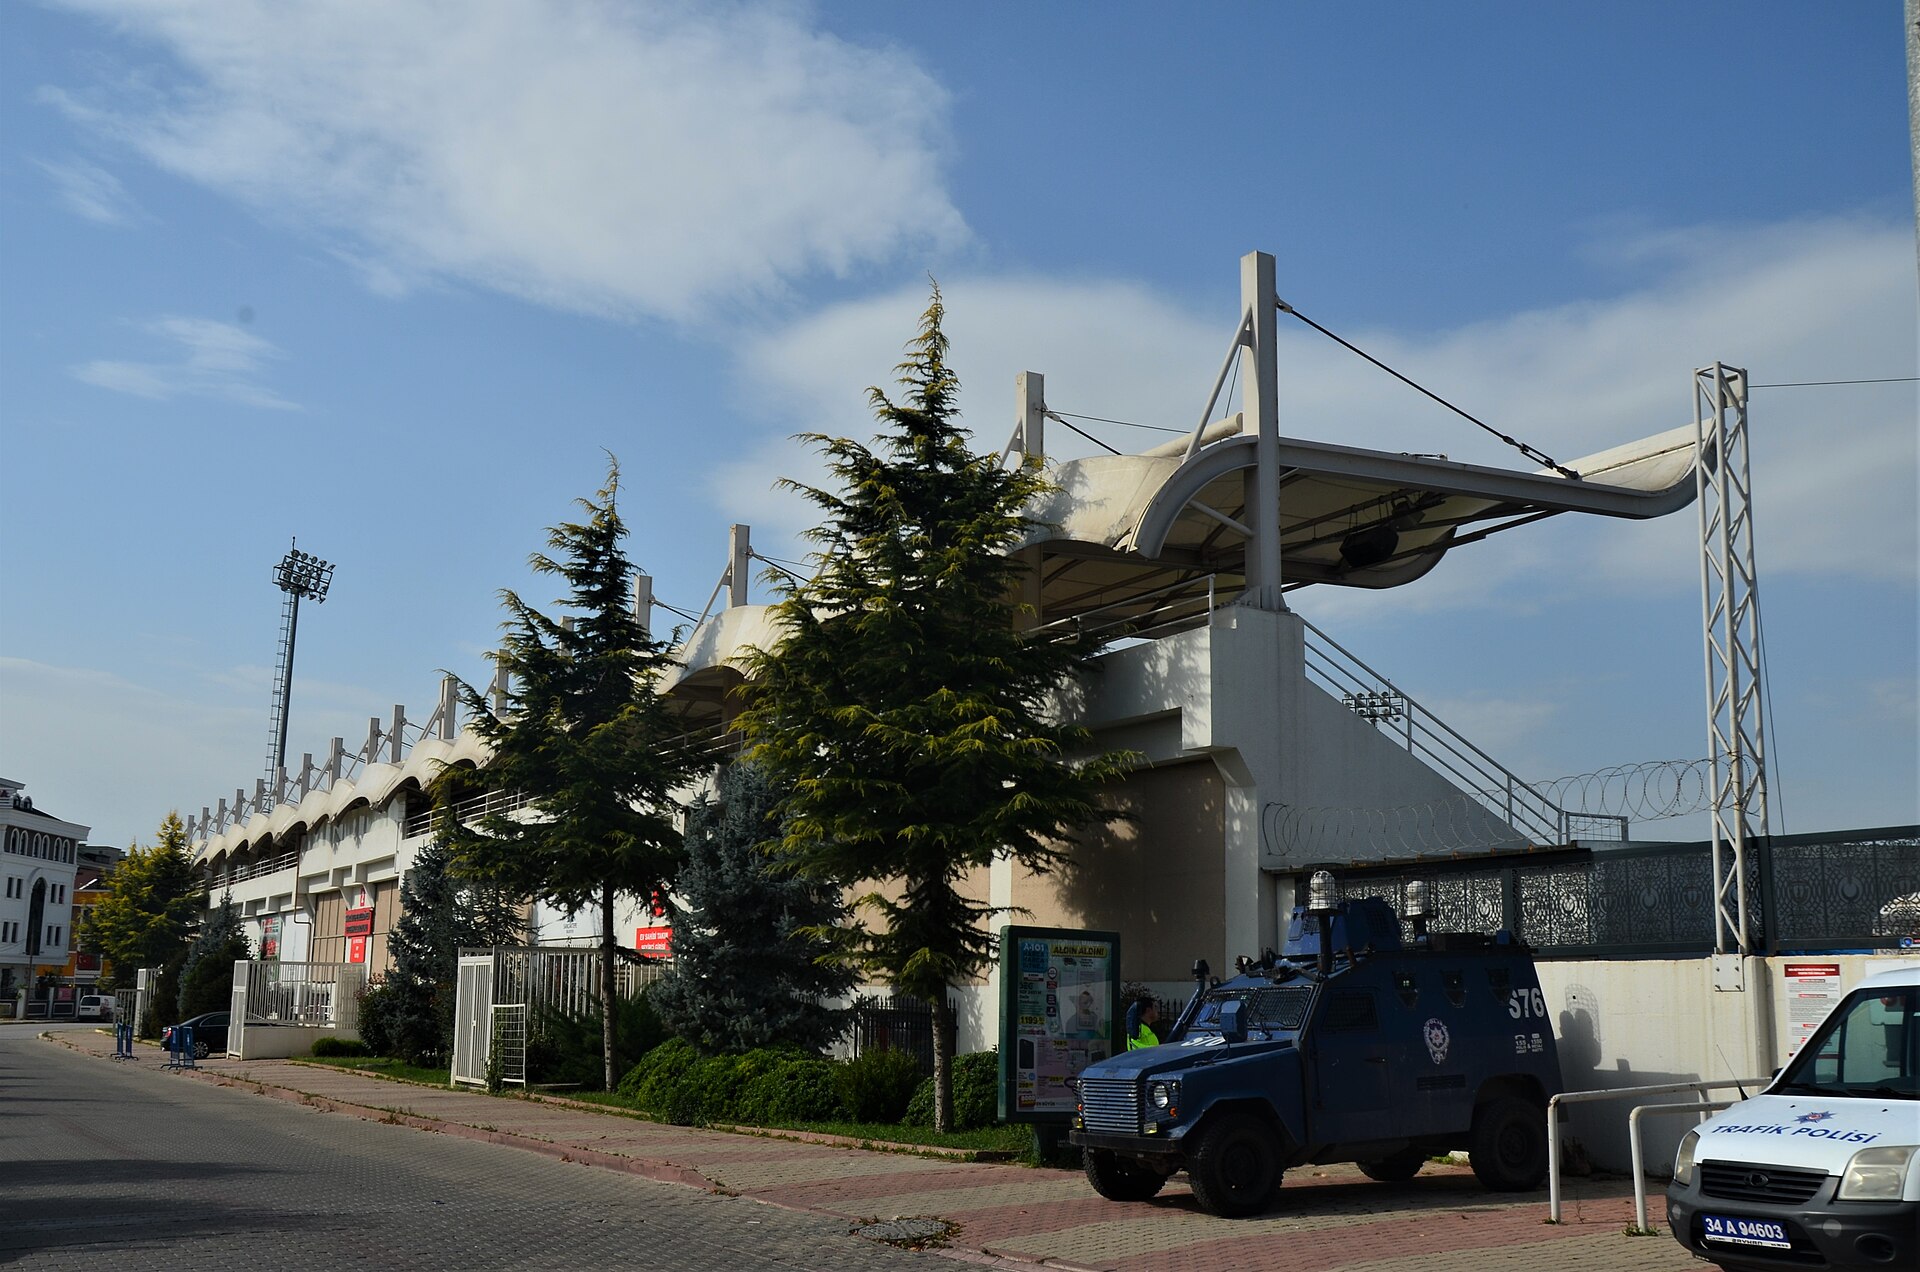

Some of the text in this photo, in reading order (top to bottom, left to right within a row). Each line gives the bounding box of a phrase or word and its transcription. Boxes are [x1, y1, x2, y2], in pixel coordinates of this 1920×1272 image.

[1712, 1123, 1882, 1144] TRAFİK POLİSİ
[1705, 1217, 1784, 1240] 34 A 94603
